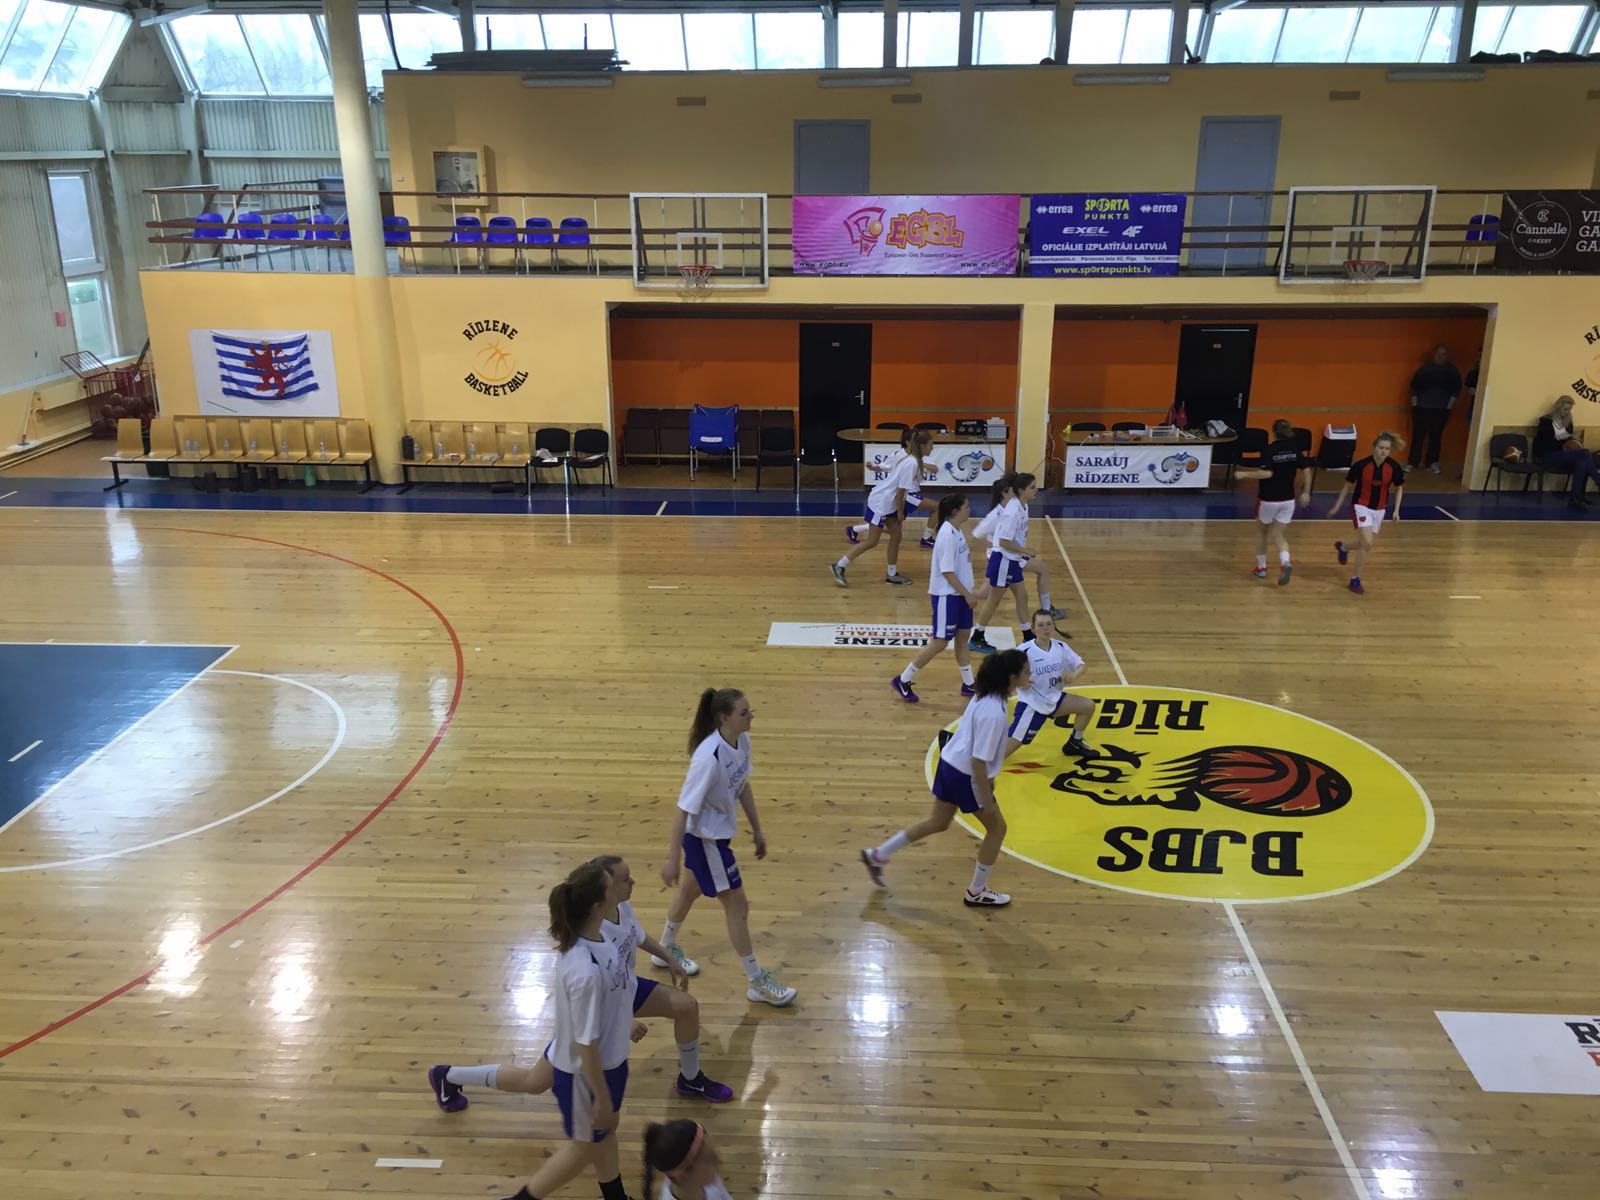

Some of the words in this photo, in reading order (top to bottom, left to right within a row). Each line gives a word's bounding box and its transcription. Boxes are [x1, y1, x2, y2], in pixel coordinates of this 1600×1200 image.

[1048, 205, 1073, 214] errea
[1152, 204, 1178, 213] errea
[1581, 210, 1600, 223] VI
[886, 207, 965, 250] EGBL
[1062, 226, 1110, 234] EXEL
[1516, 222, 1568, 235] Cannelle
[1042, 242, 1083, 251] OFICIĀLIE
[1085, 241, 1132, 251] IZPLATĪTĀJI
[1134, 241, 1167, 251] LATVIJĀ
[1575, 240, 1600, 252] GA
[1054, 265, 1152, 275] www.sportapunkts.lv
[462, 319, 519, 341] RĪDZENE
[464, 371, 529, 397] BASKETBALL
[1571, 378, 1600, 403] BASK
[1076, 456, 1130, 470] SARAUJ
[1074, 471, 1140, 484] RĪDZENE
[835, 630, 935, 638] ASKETBALL
[1564, 1018, 1600, 1044] R
